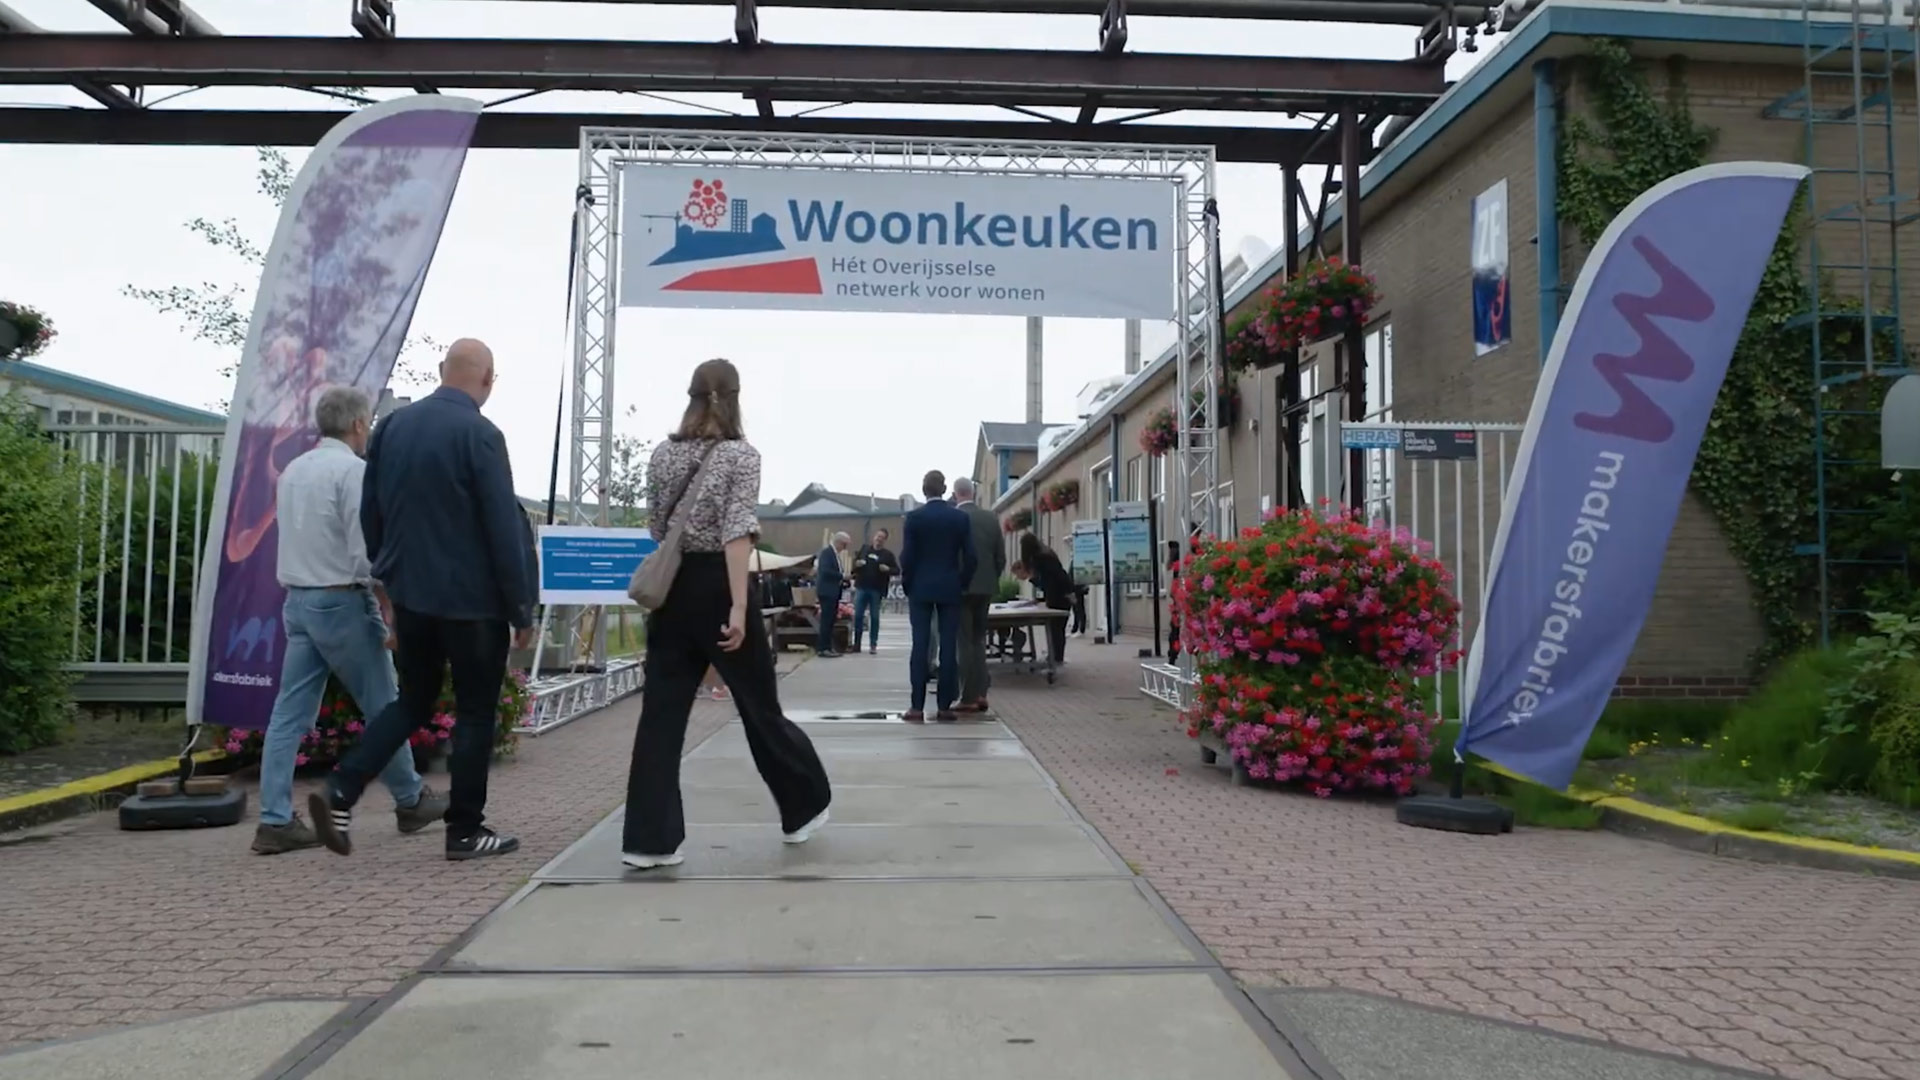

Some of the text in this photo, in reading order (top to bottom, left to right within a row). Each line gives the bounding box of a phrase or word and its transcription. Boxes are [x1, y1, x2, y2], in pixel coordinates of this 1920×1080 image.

[788, 199, 1158, 251] Woonkeuken
[831, 256, 996, 280] Hét Overijsselse
[836, 281, 1045, 301] netwerk voor wonen
[1343, 430, 1399, 442] HERAS
[1502, 450, 1625, 727] makersfabriek
